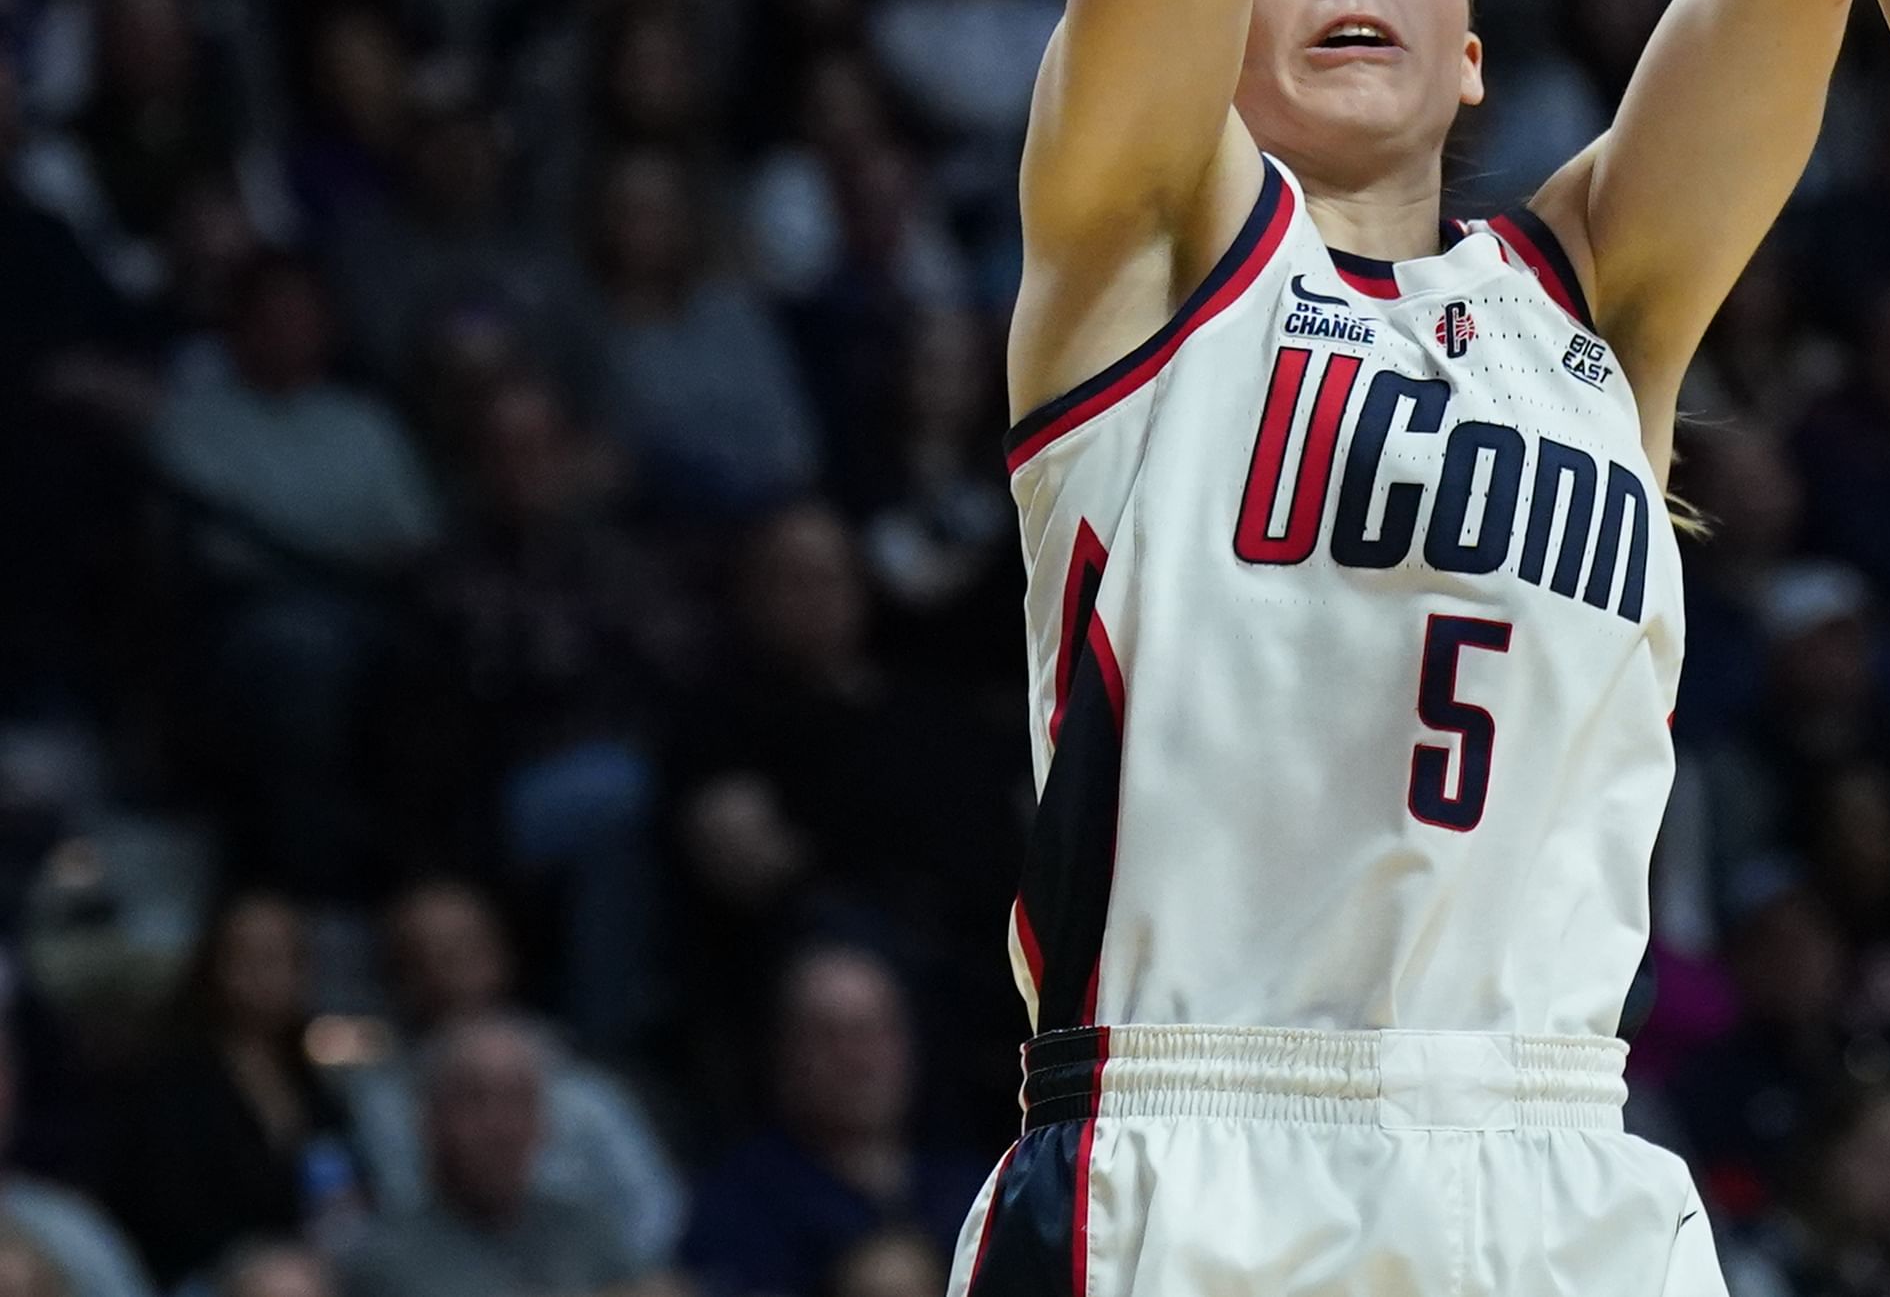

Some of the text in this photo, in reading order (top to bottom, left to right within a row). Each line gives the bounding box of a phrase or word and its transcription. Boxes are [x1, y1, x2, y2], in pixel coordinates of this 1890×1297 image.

[1284, 312, 1376, 345] CHANGE
[1569, 333, 1606, 362] BIG
[1561, 350, 1613, 384] EAST
[1407, 613, 1513, 833] 5
